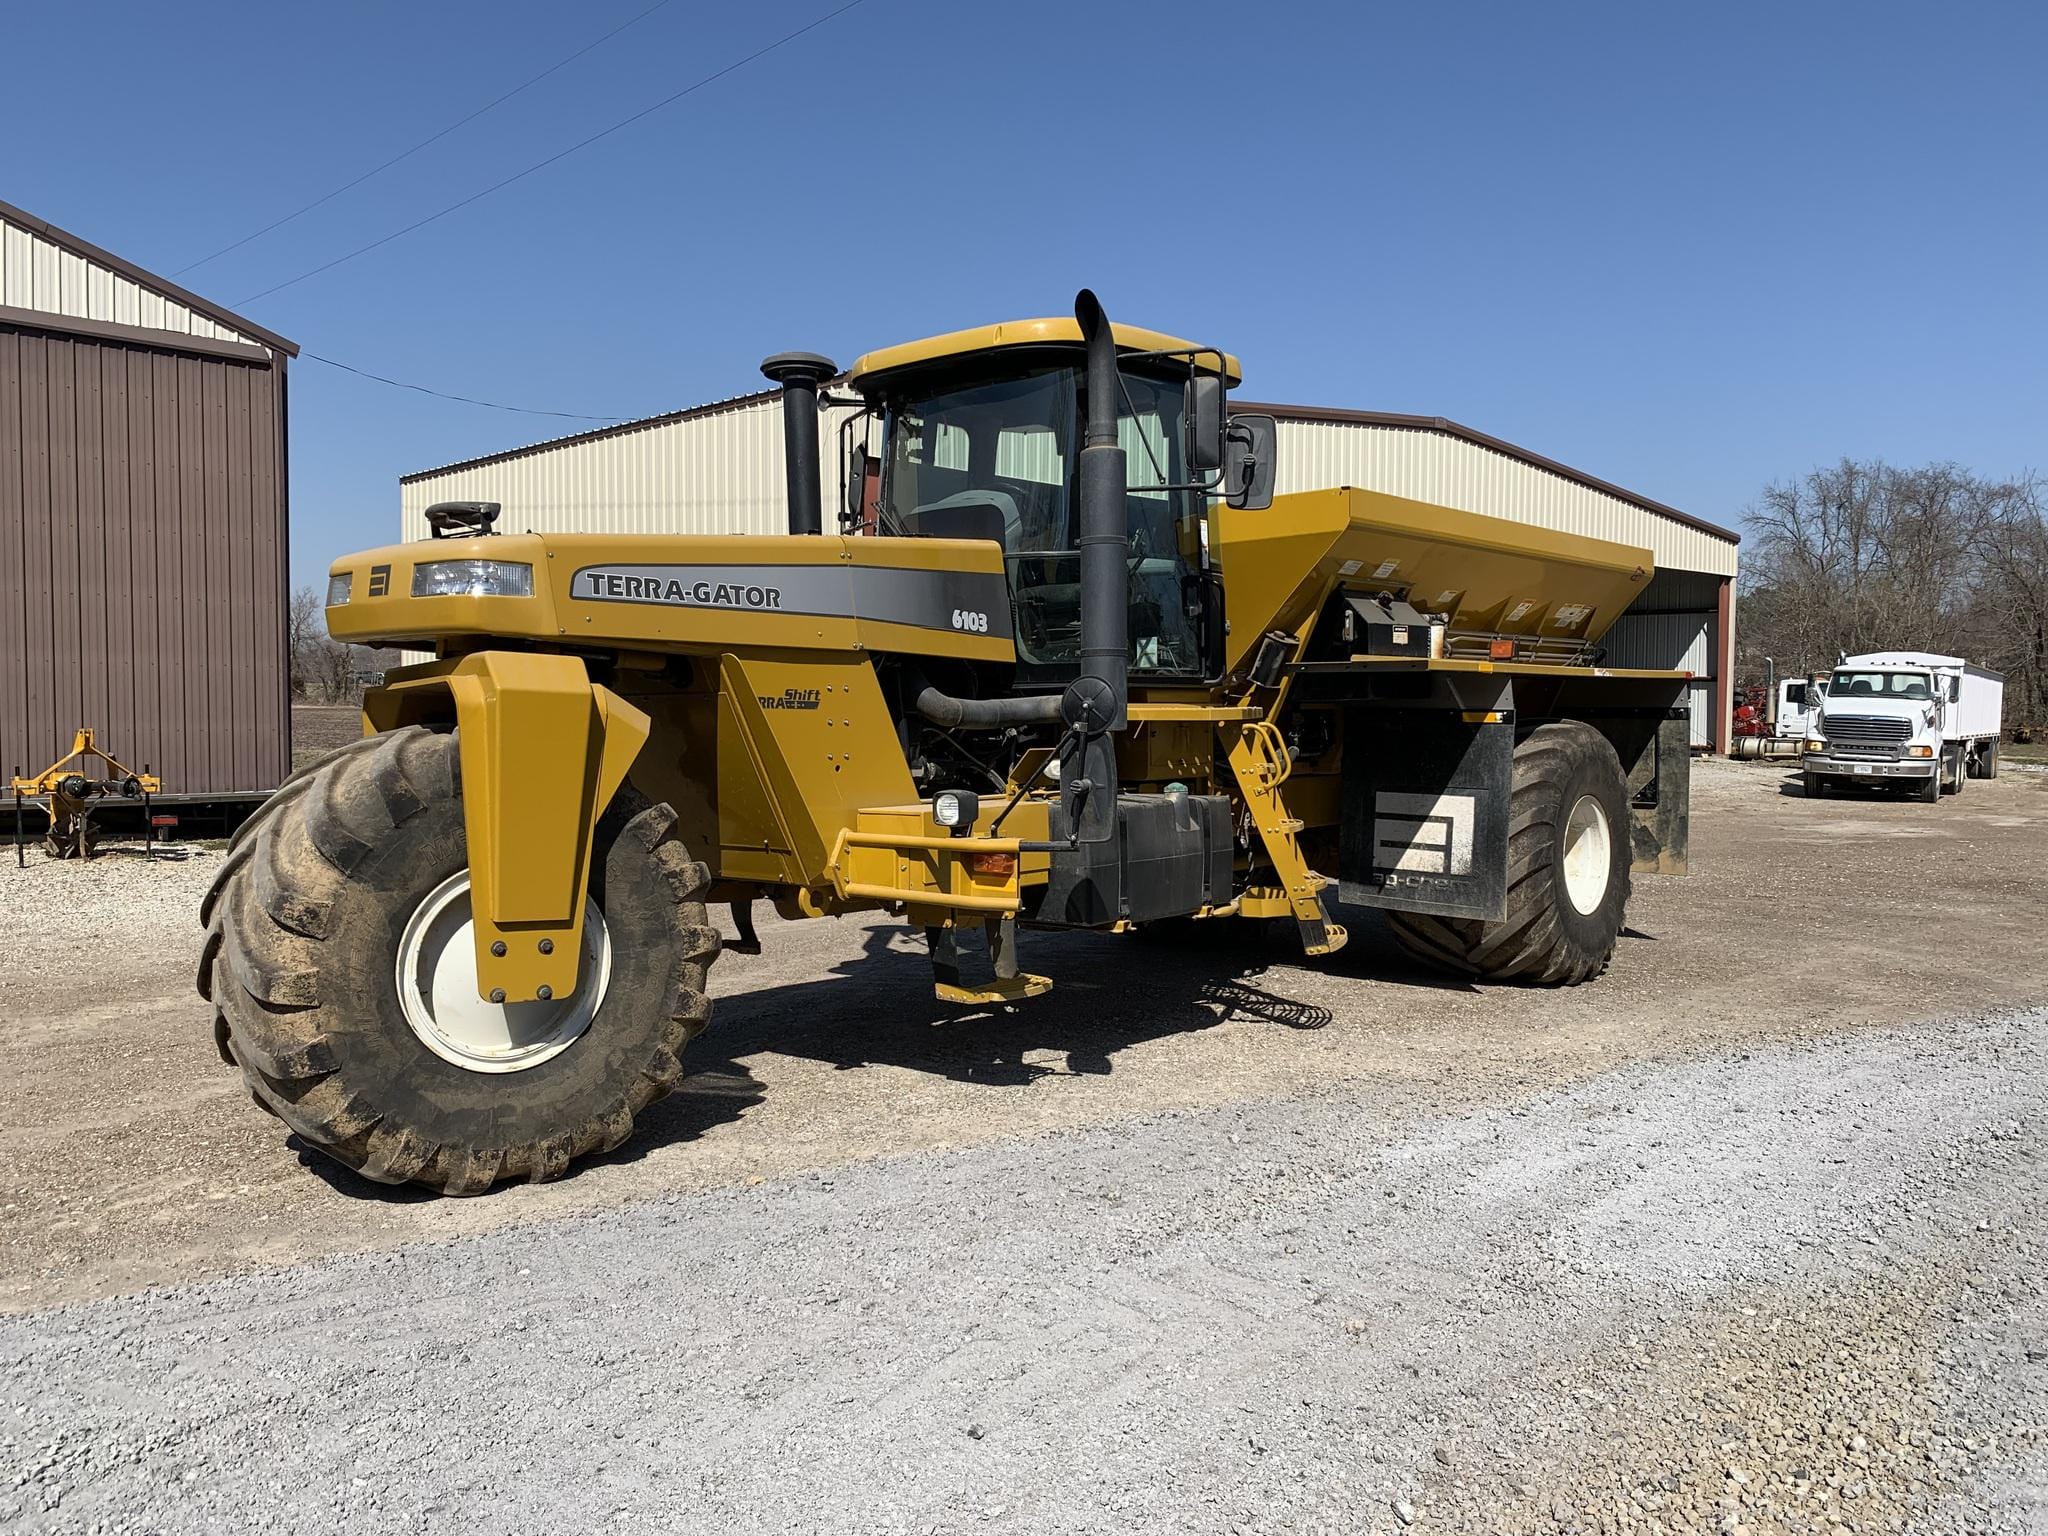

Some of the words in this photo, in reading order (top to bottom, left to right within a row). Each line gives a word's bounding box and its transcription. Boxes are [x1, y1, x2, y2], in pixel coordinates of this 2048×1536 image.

[586, 572, 781, 608] TERRA-GATOR
[951, 608, 988, 632] 6103
[784, 688, 821, 701] Shift
